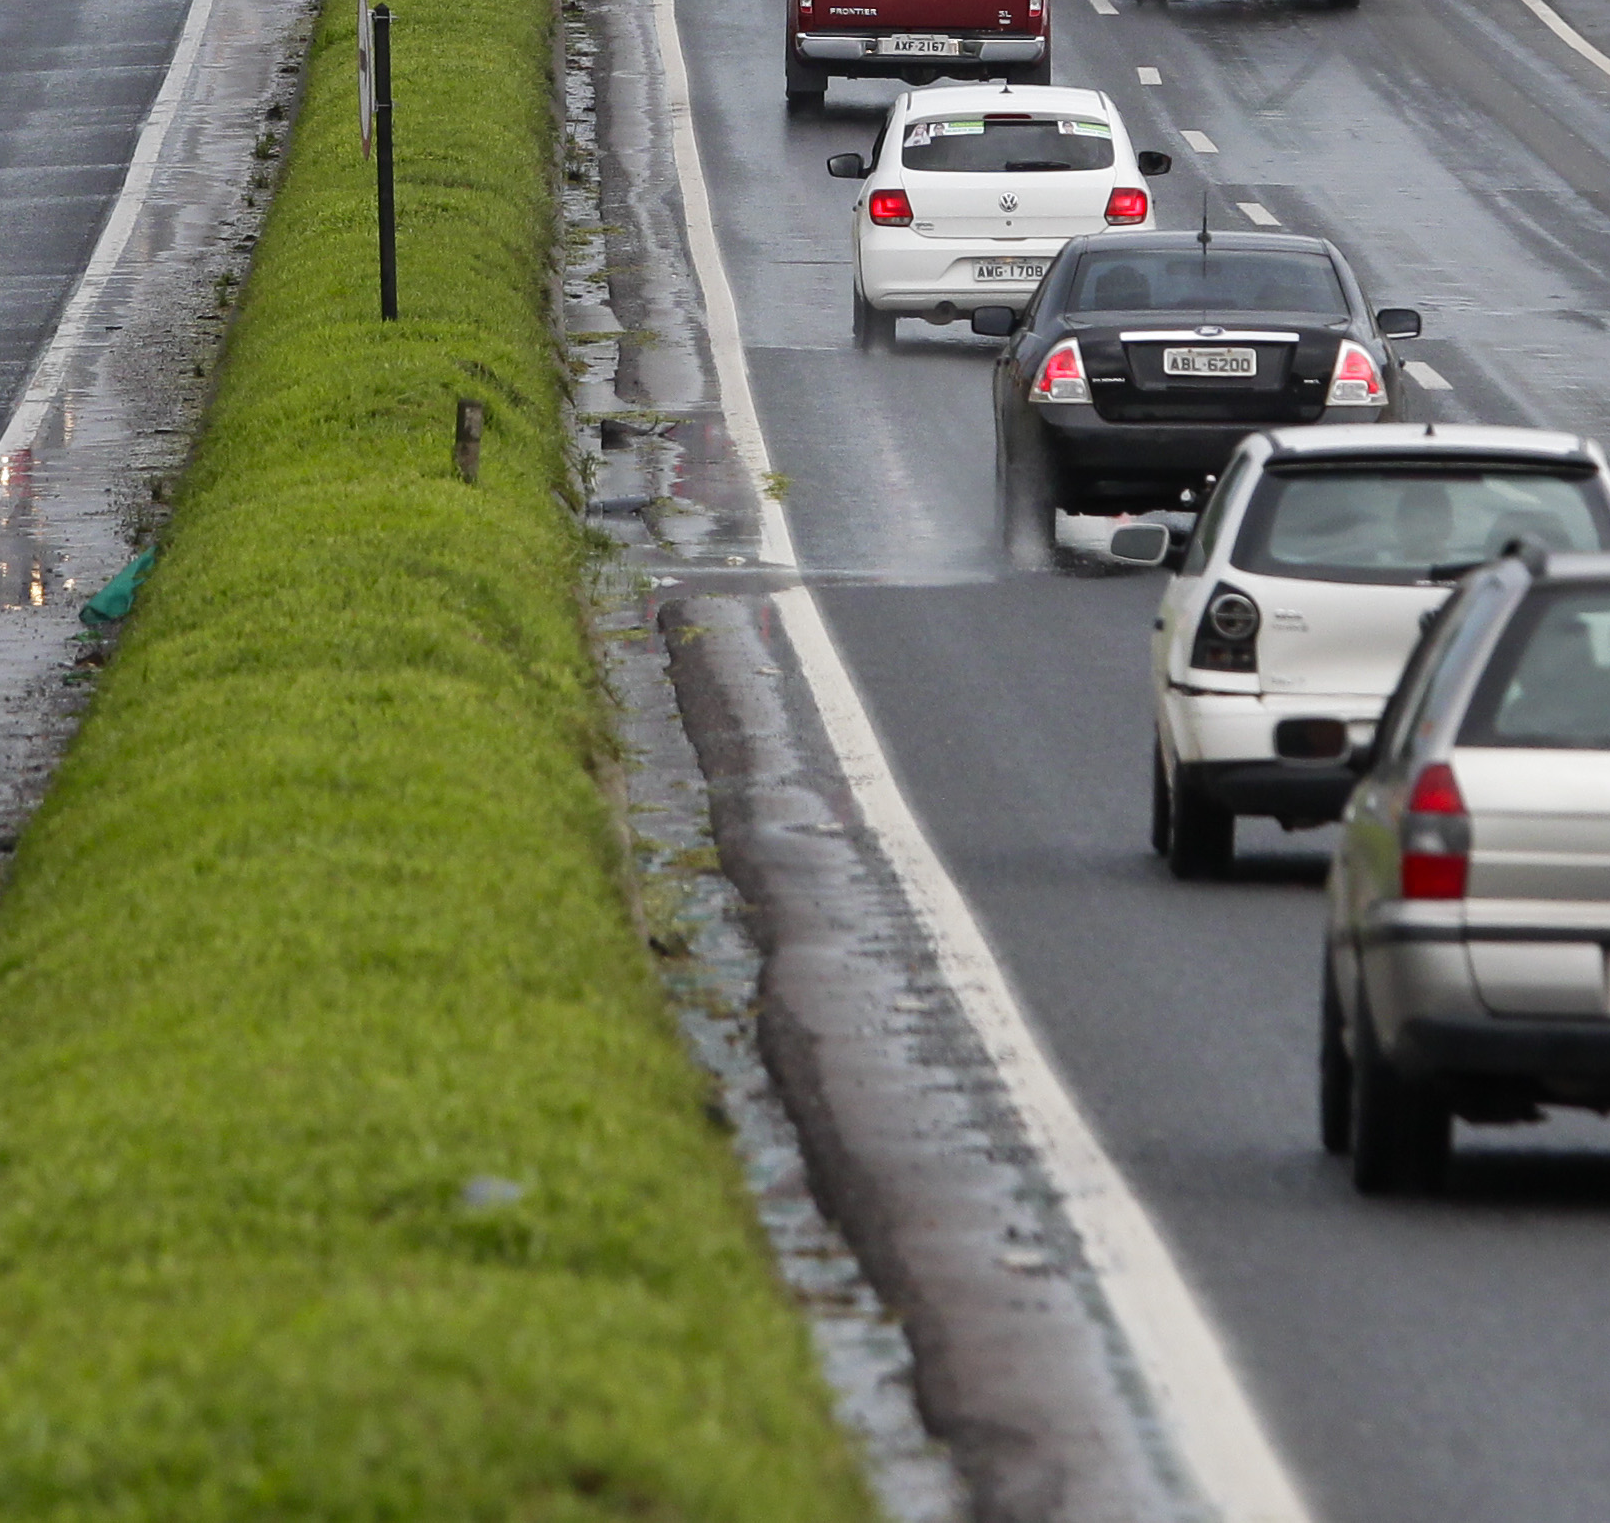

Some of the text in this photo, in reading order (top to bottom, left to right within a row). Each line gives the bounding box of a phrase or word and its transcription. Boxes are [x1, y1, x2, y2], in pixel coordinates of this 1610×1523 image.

[829, 7, 878, 16] FRONTIER
[894, 40, 946, 53] AXF-2167
[1169, 357, 1251, 373] ABL-6200
